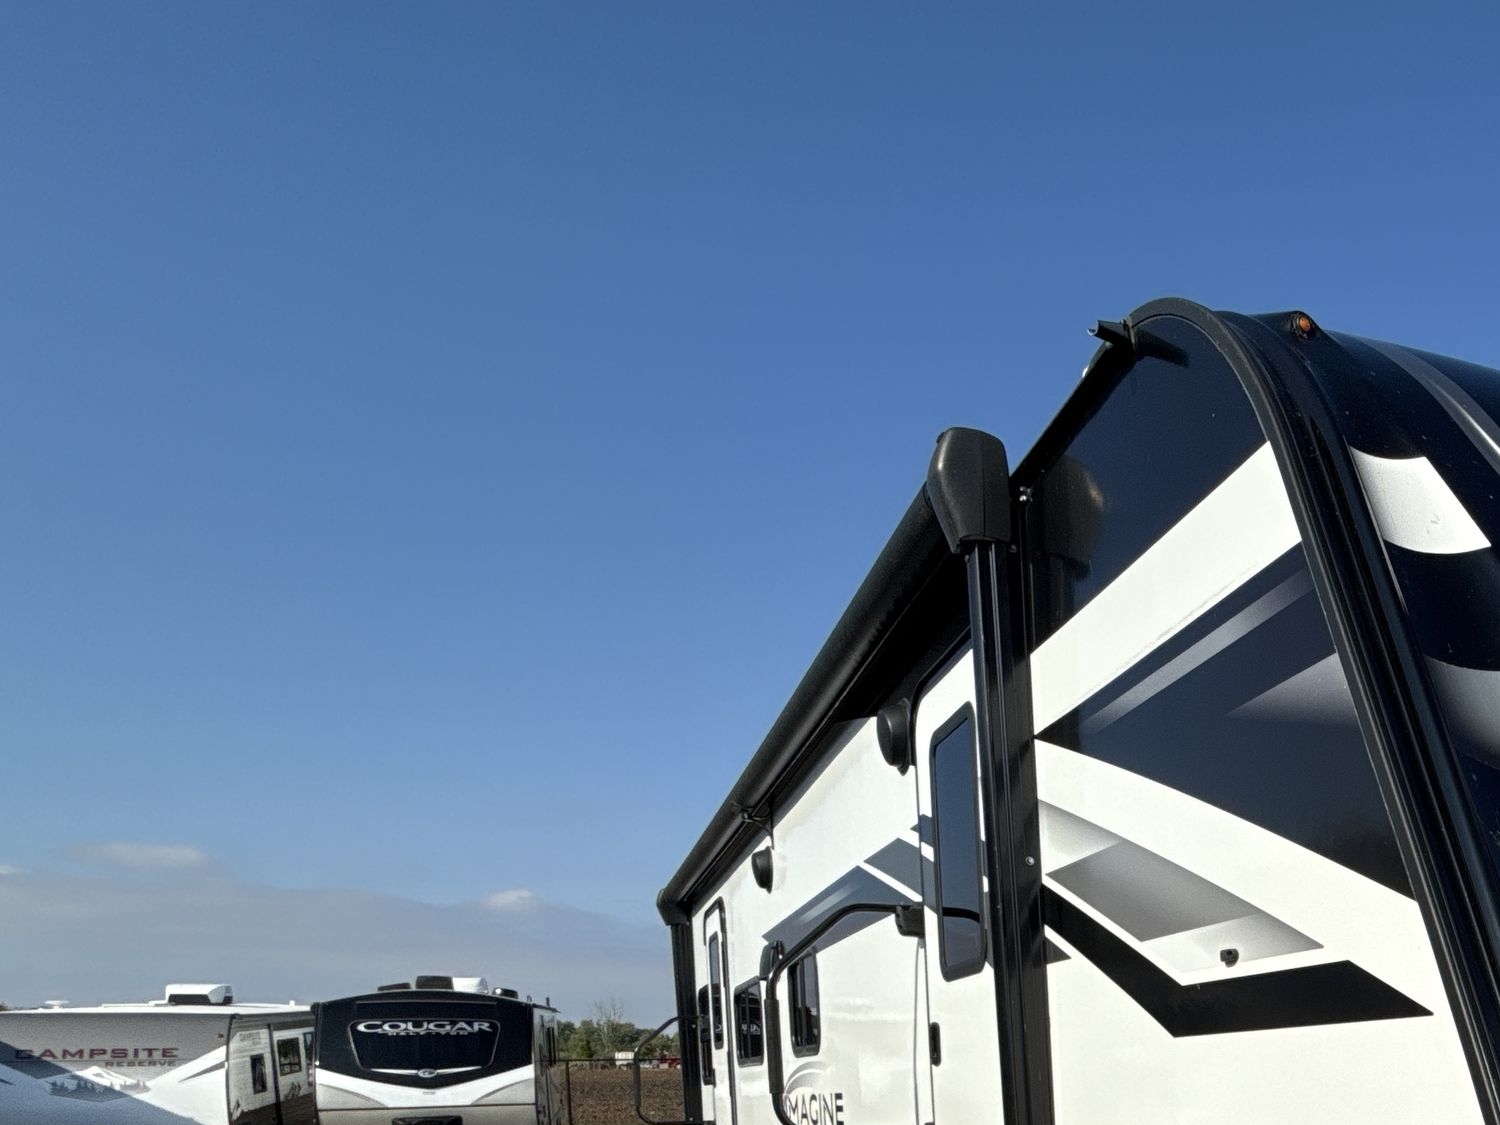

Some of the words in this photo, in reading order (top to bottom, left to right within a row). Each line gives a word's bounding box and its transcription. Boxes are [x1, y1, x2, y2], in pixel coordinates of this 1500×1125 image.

[356, 1020, 493, 1033] COUGAR
[15, 1047, 179, 1060] CAMPSITE
[104, 1060, 177, 1068] RESERVE
